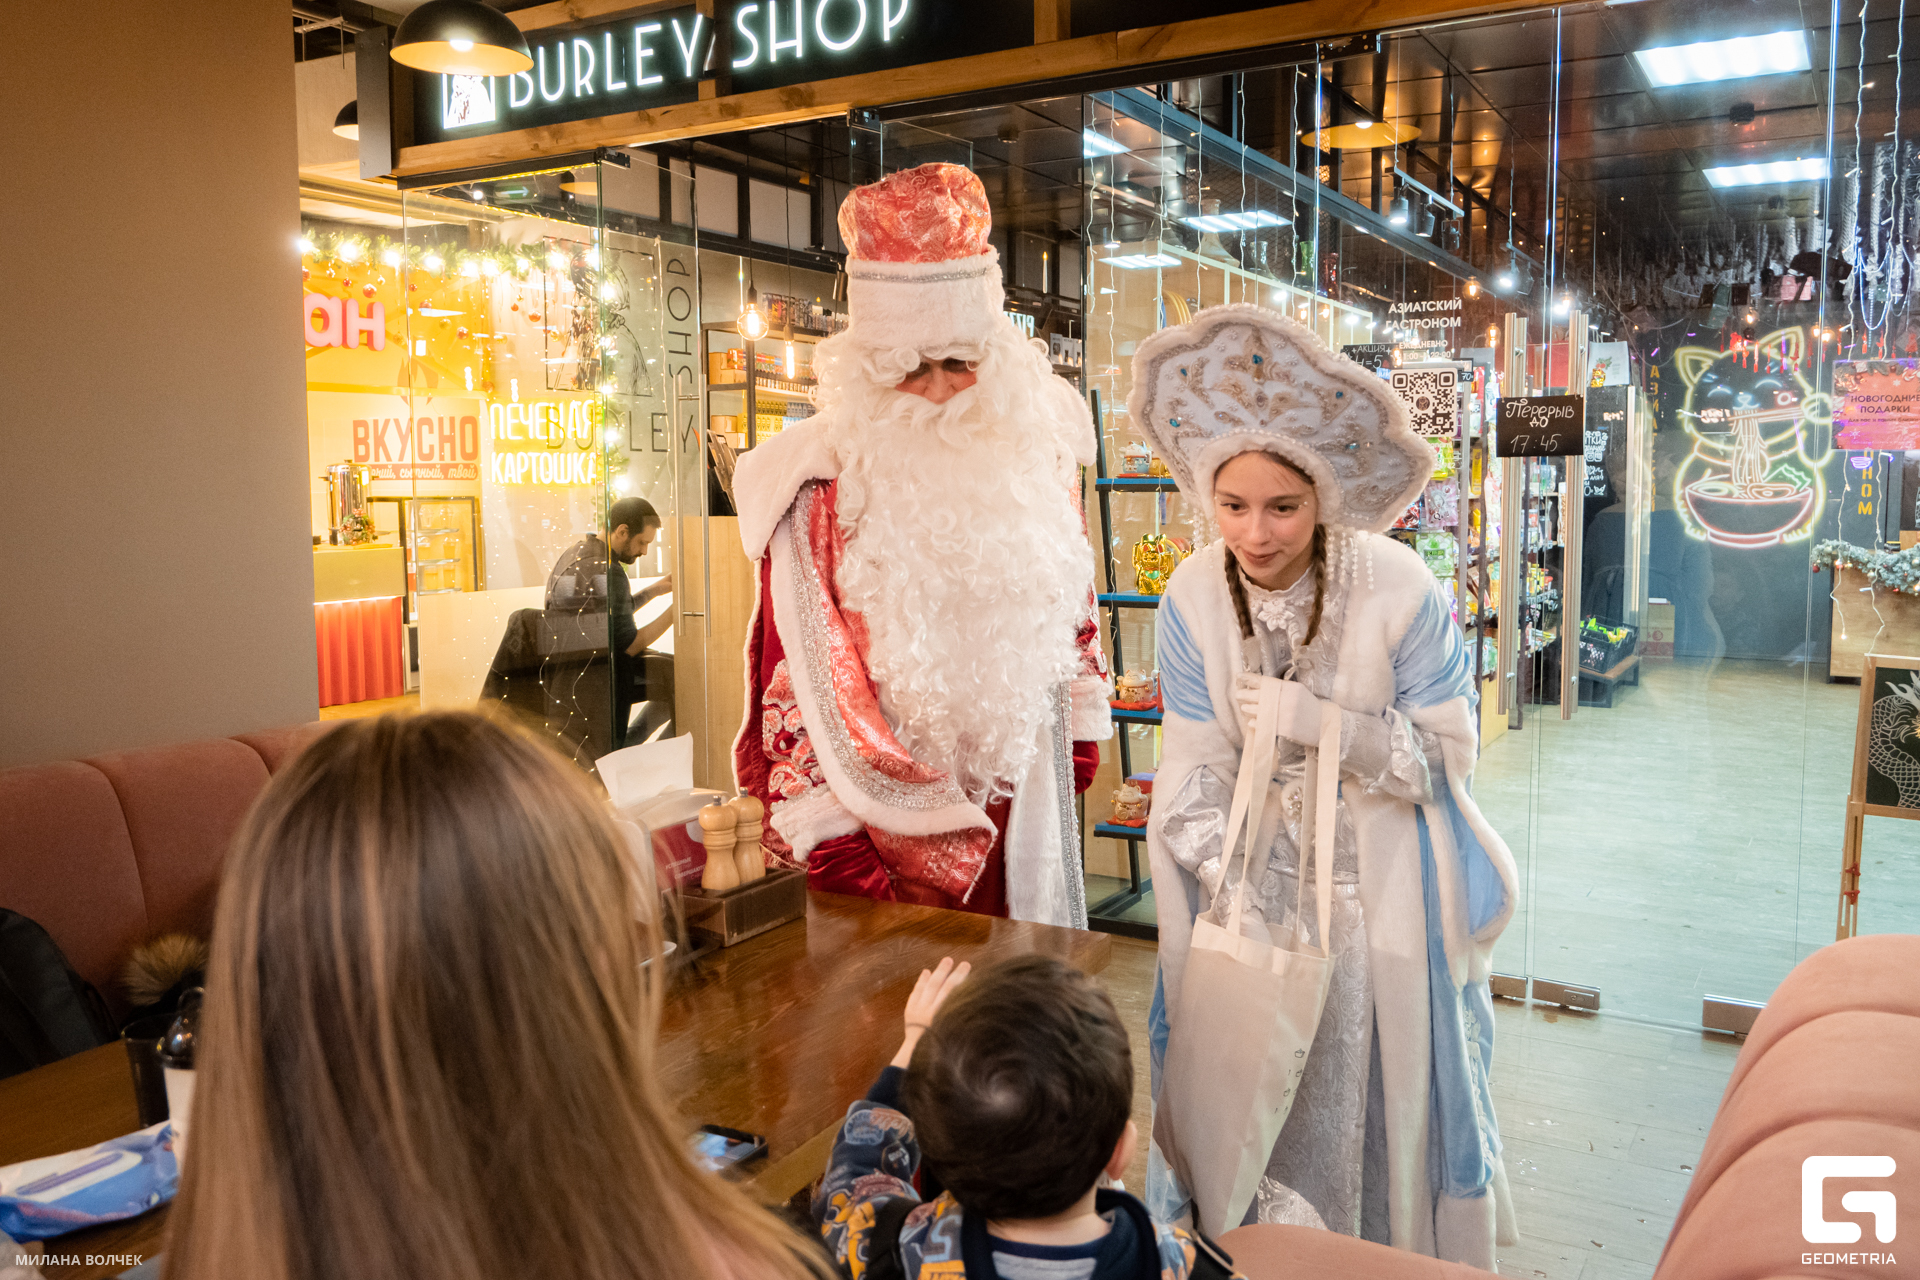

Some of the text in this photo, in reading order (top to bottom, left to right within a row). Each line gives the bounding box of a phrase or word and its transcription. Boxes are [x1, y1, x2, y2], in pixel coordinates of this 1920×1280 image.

[509, 0, 910, 109] BURLEY SHOP
[1388, 297, 1462, 314] АЗИАТСКИЙ
[666, 258, 693, 384] SHOP
[1385, 316, 1461, 331] ГАСТРОНОМ
[1357, 345, 1386, 353] АКЦИЯ
[1851, 394, 1920, 402] НОВОГОДНИЕ
[1860, 405, 1910, 413] ПОДАРКИ
[546, 406, 694, 453] BULEY
[353, 416, 479, 463] ВКУСНО
[447, 464, 476, 479] твой
[491, 452, 597, 485] КАРТОШКА
